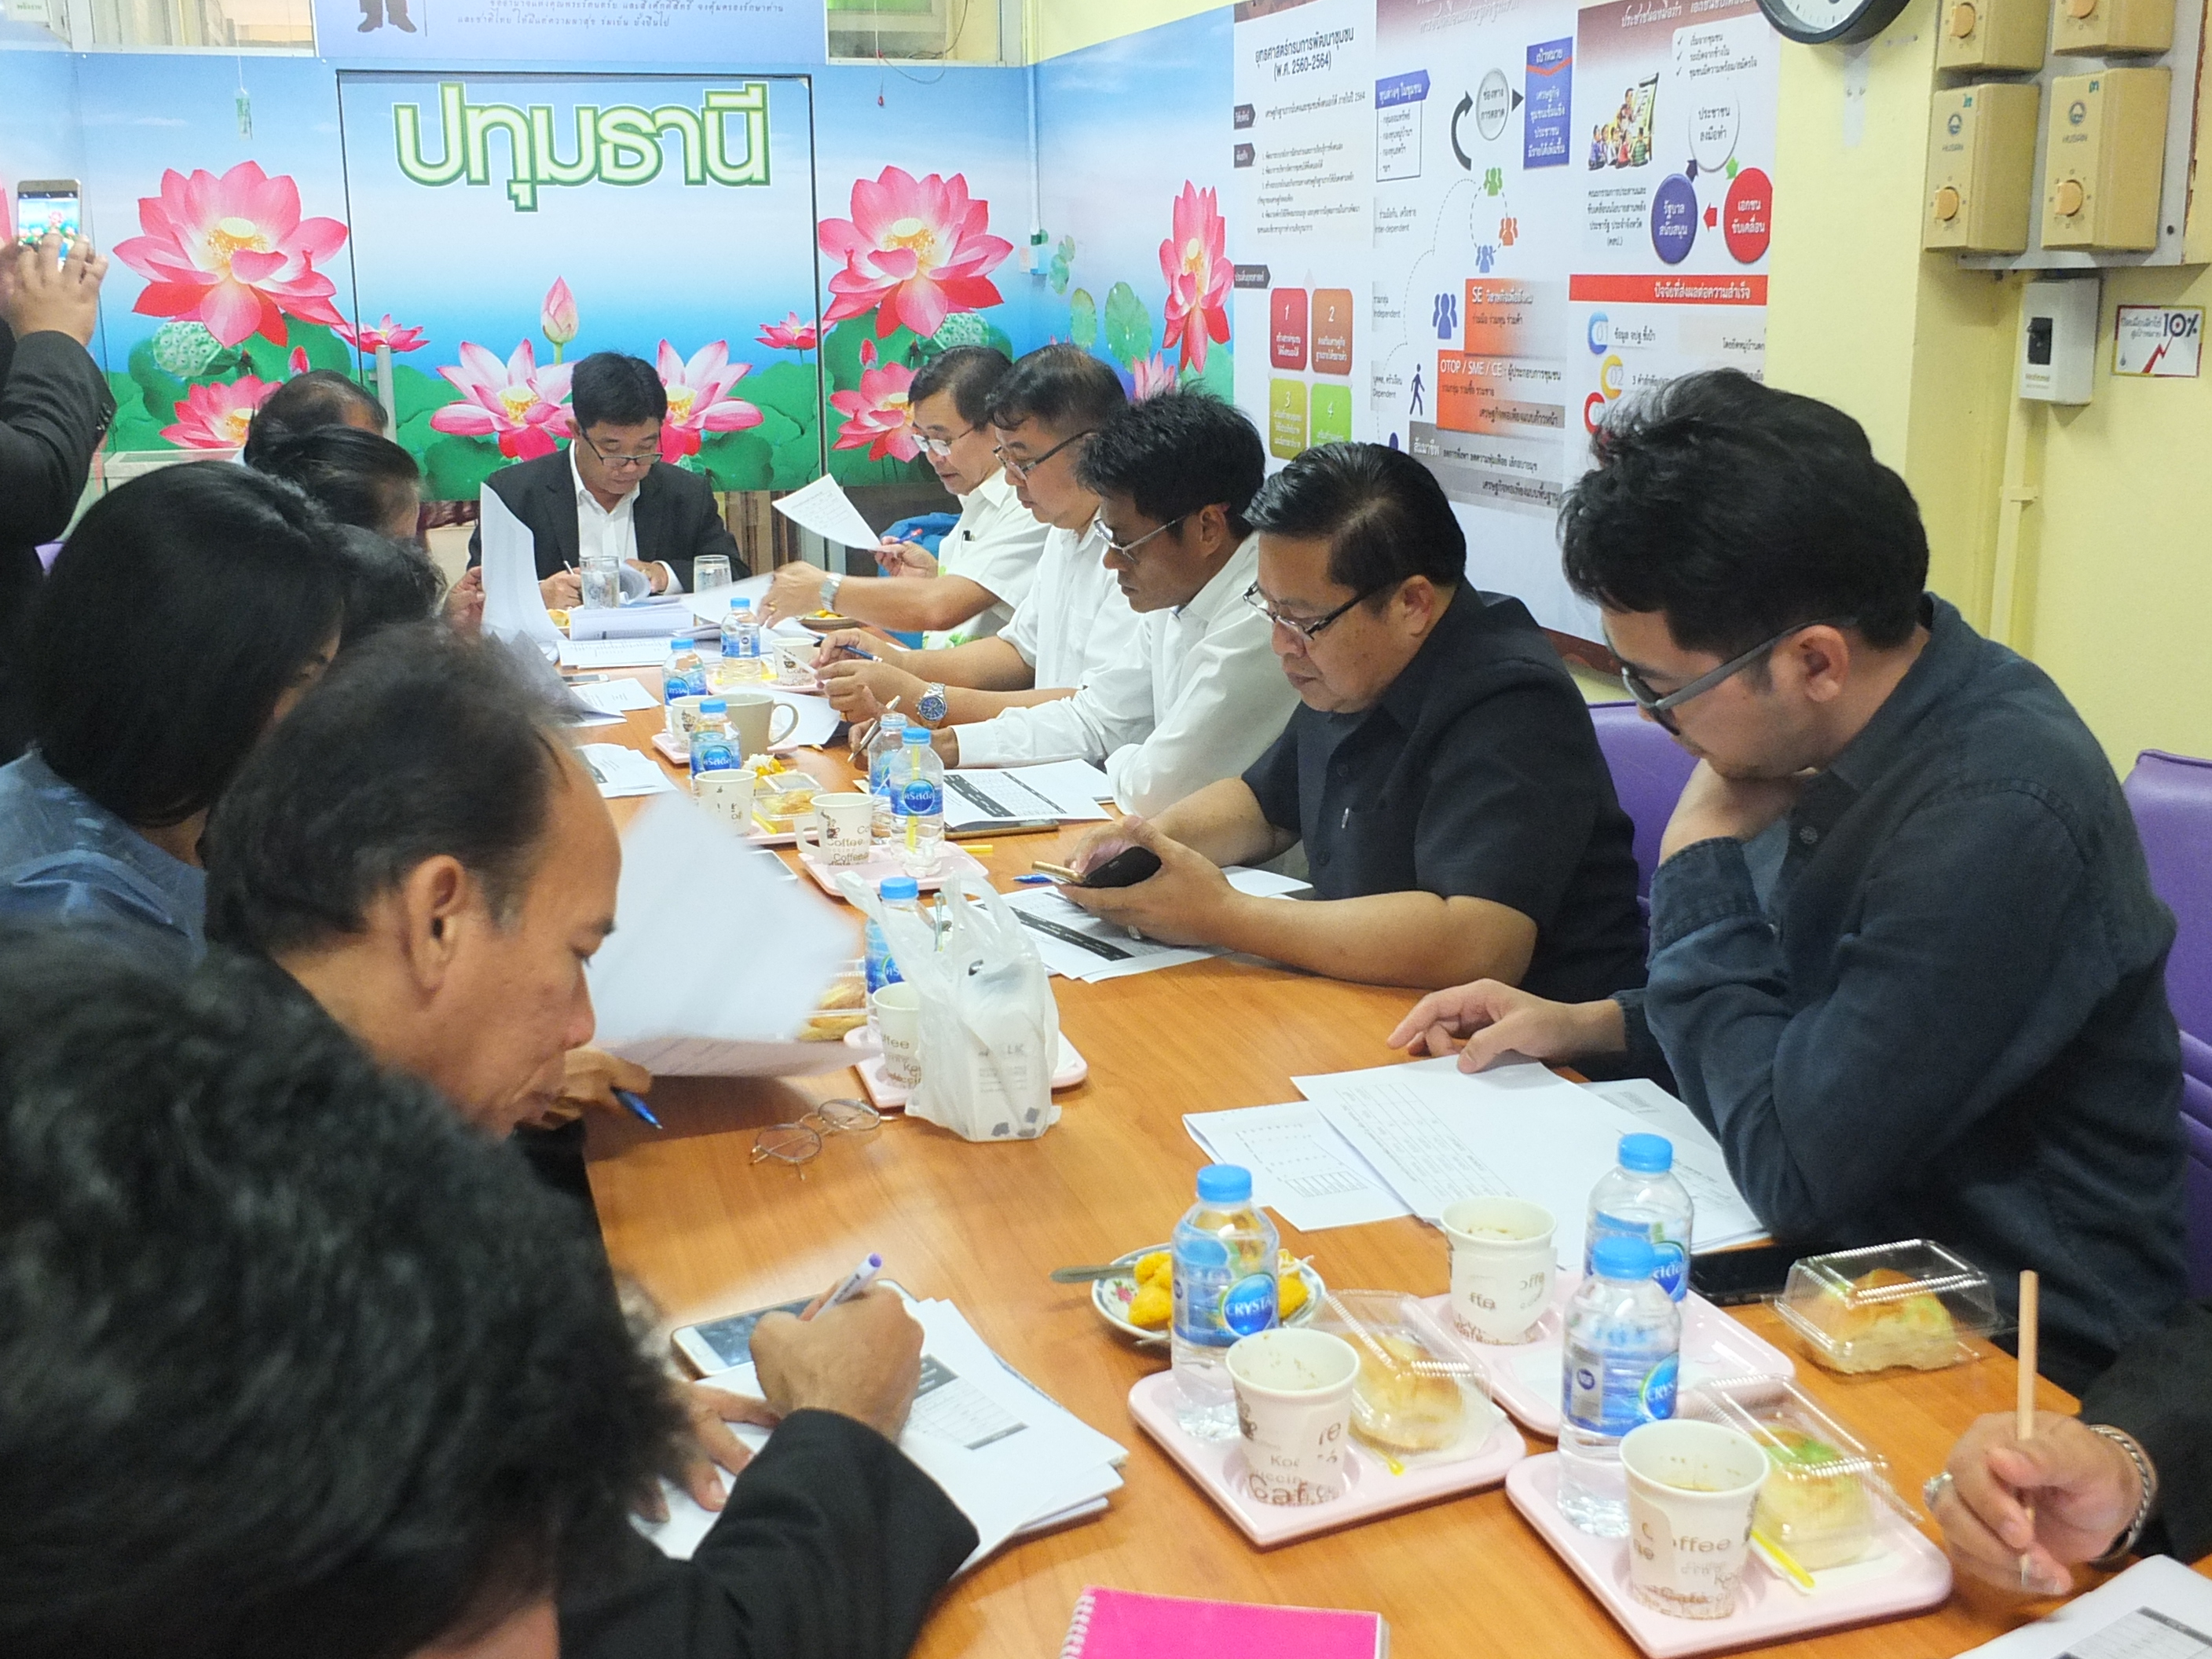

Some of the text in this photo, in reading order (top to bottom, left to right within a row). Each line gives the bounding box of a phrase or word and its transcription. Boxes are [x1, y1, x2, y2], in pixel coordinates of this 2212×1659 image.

[1255, 27, 1354, 68] ยุทธศาสตร์กรมการพัฒนาชุมชน
[1291, 50, 1332, 75] 2560-2564)
[1699, 107, 1730, 120] ประชาชน
[1700, 125, 1727, 142] ลงมือทำ
[393, 81, 771, 214] ปทุมธานี
[1663, 200, 1686, 219] รัฐบาล
[1738, 200, 1762, 212] เอกชน
[1658, 222, 1688, 240] สนับสนุน
[1731, 214, 1766, 235] ขับเคลื่อน
[1471, 286, 1484, 304] SE
[1654, 278, 1751, 299] ปัจจัยที่ส่งผลต่อความสำเร็จ
[1284, 303, 1290, 320] 1
[1328, 306, 1335, 323] 2
[2163, 313, 2199, 338] 10%
[1440, 359, 1461, 373] OTOP
[1468, 361, 1485, 376] SME
[1492, 362, 1503, 377] CE
[1284, 390, 1291, 408] 3
[1327, 401, 1334, 419] 4
